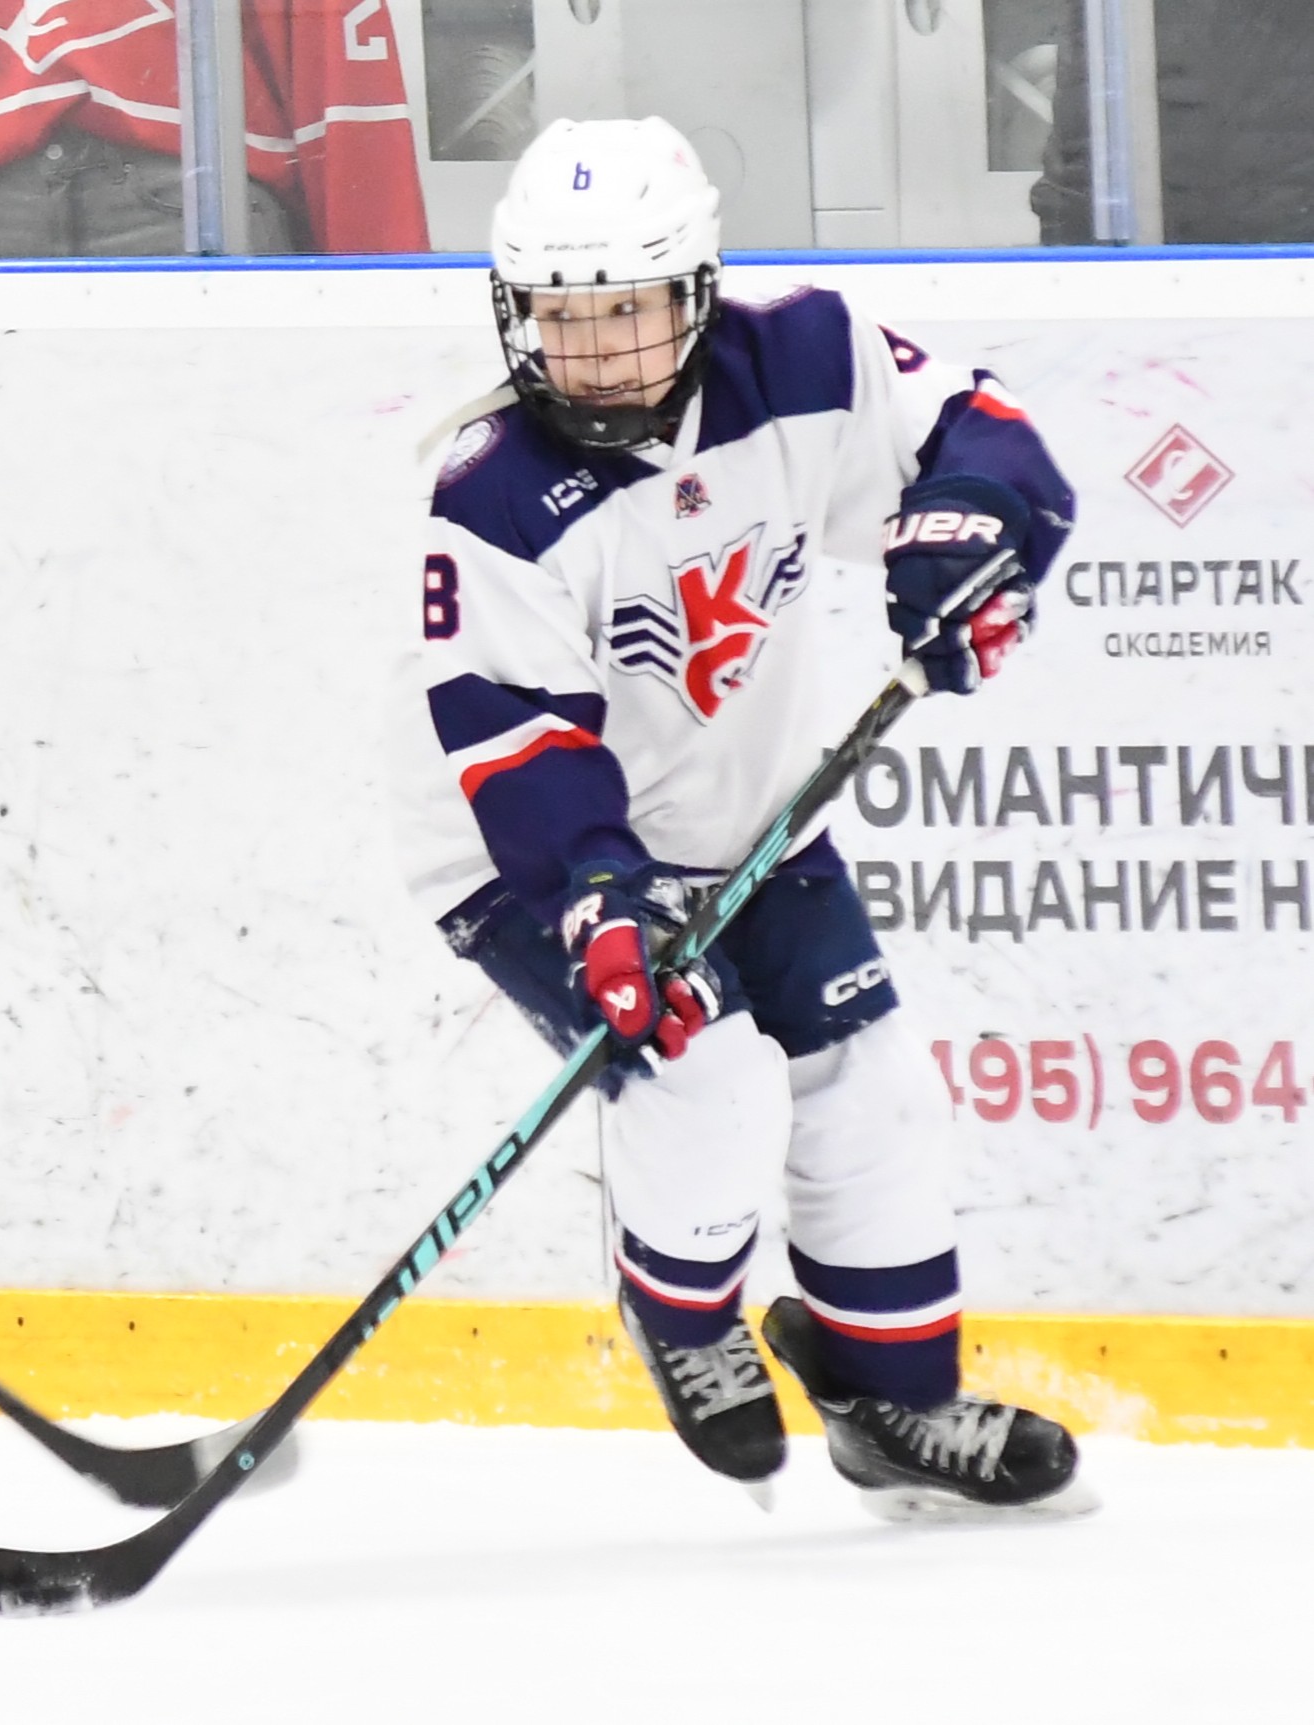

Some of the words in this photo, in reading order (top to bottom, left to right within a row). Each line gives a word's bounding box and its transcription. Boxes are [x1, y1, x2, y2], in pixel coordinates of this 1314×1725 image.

[1065, 558, 1304, 608] СПАРТАК
[822, 744, 1314, 829] ОМАНТИЧ
[822, 956, 890, 1007] CC
